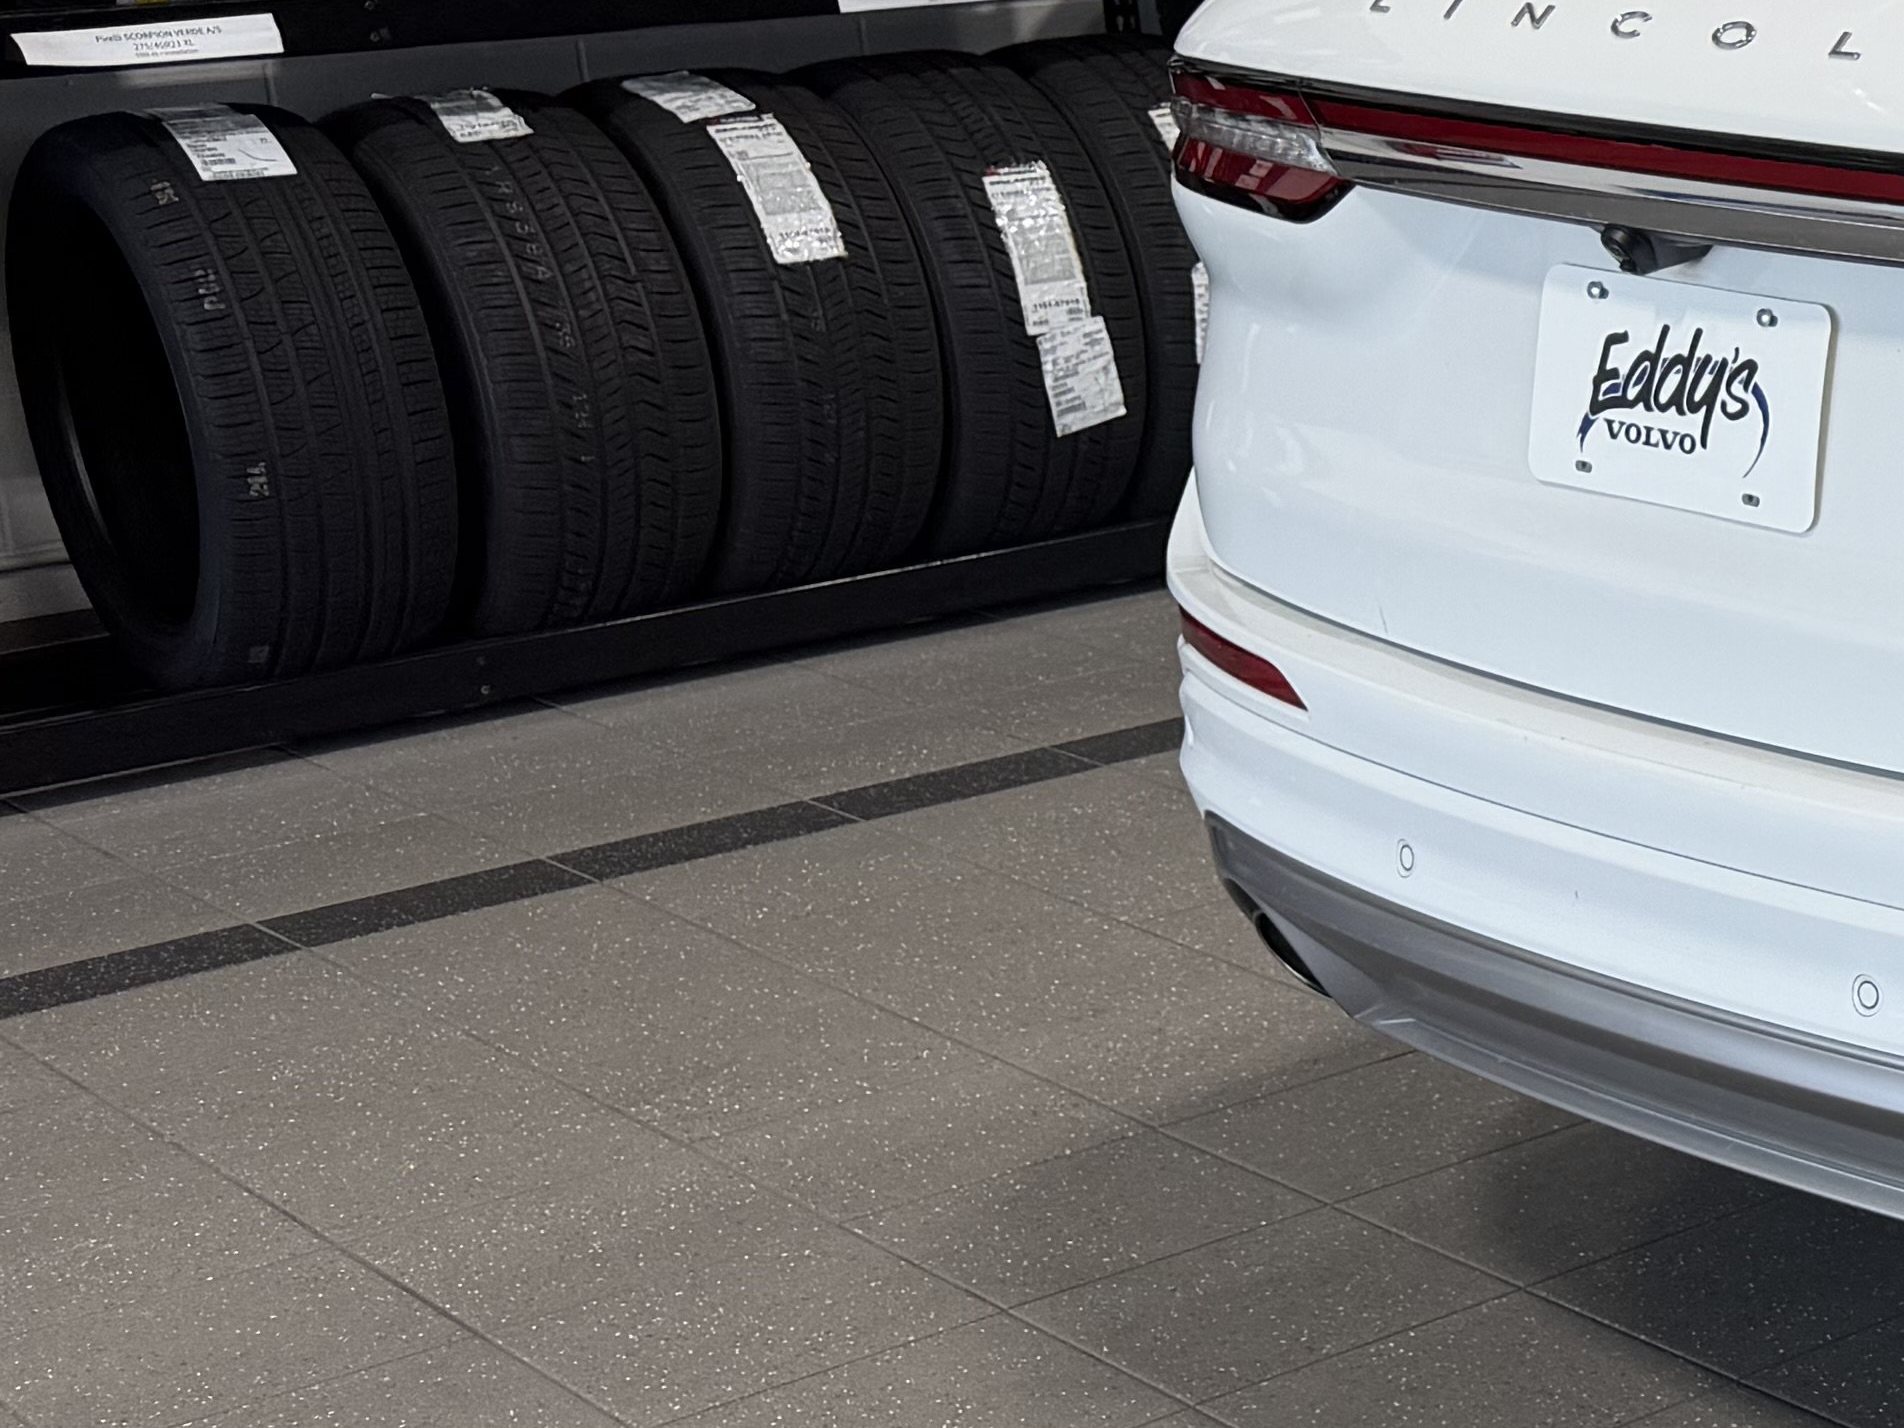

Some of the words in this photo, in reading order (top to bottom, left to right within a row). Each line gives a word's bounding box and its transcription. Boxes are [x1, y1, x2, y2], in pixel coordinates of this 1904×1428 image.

[123, 30, 173, 41] SCORPION
[1588, 323, 1759, 450] Eddy's
[1603, 417, 1697, 455] VOLVO
